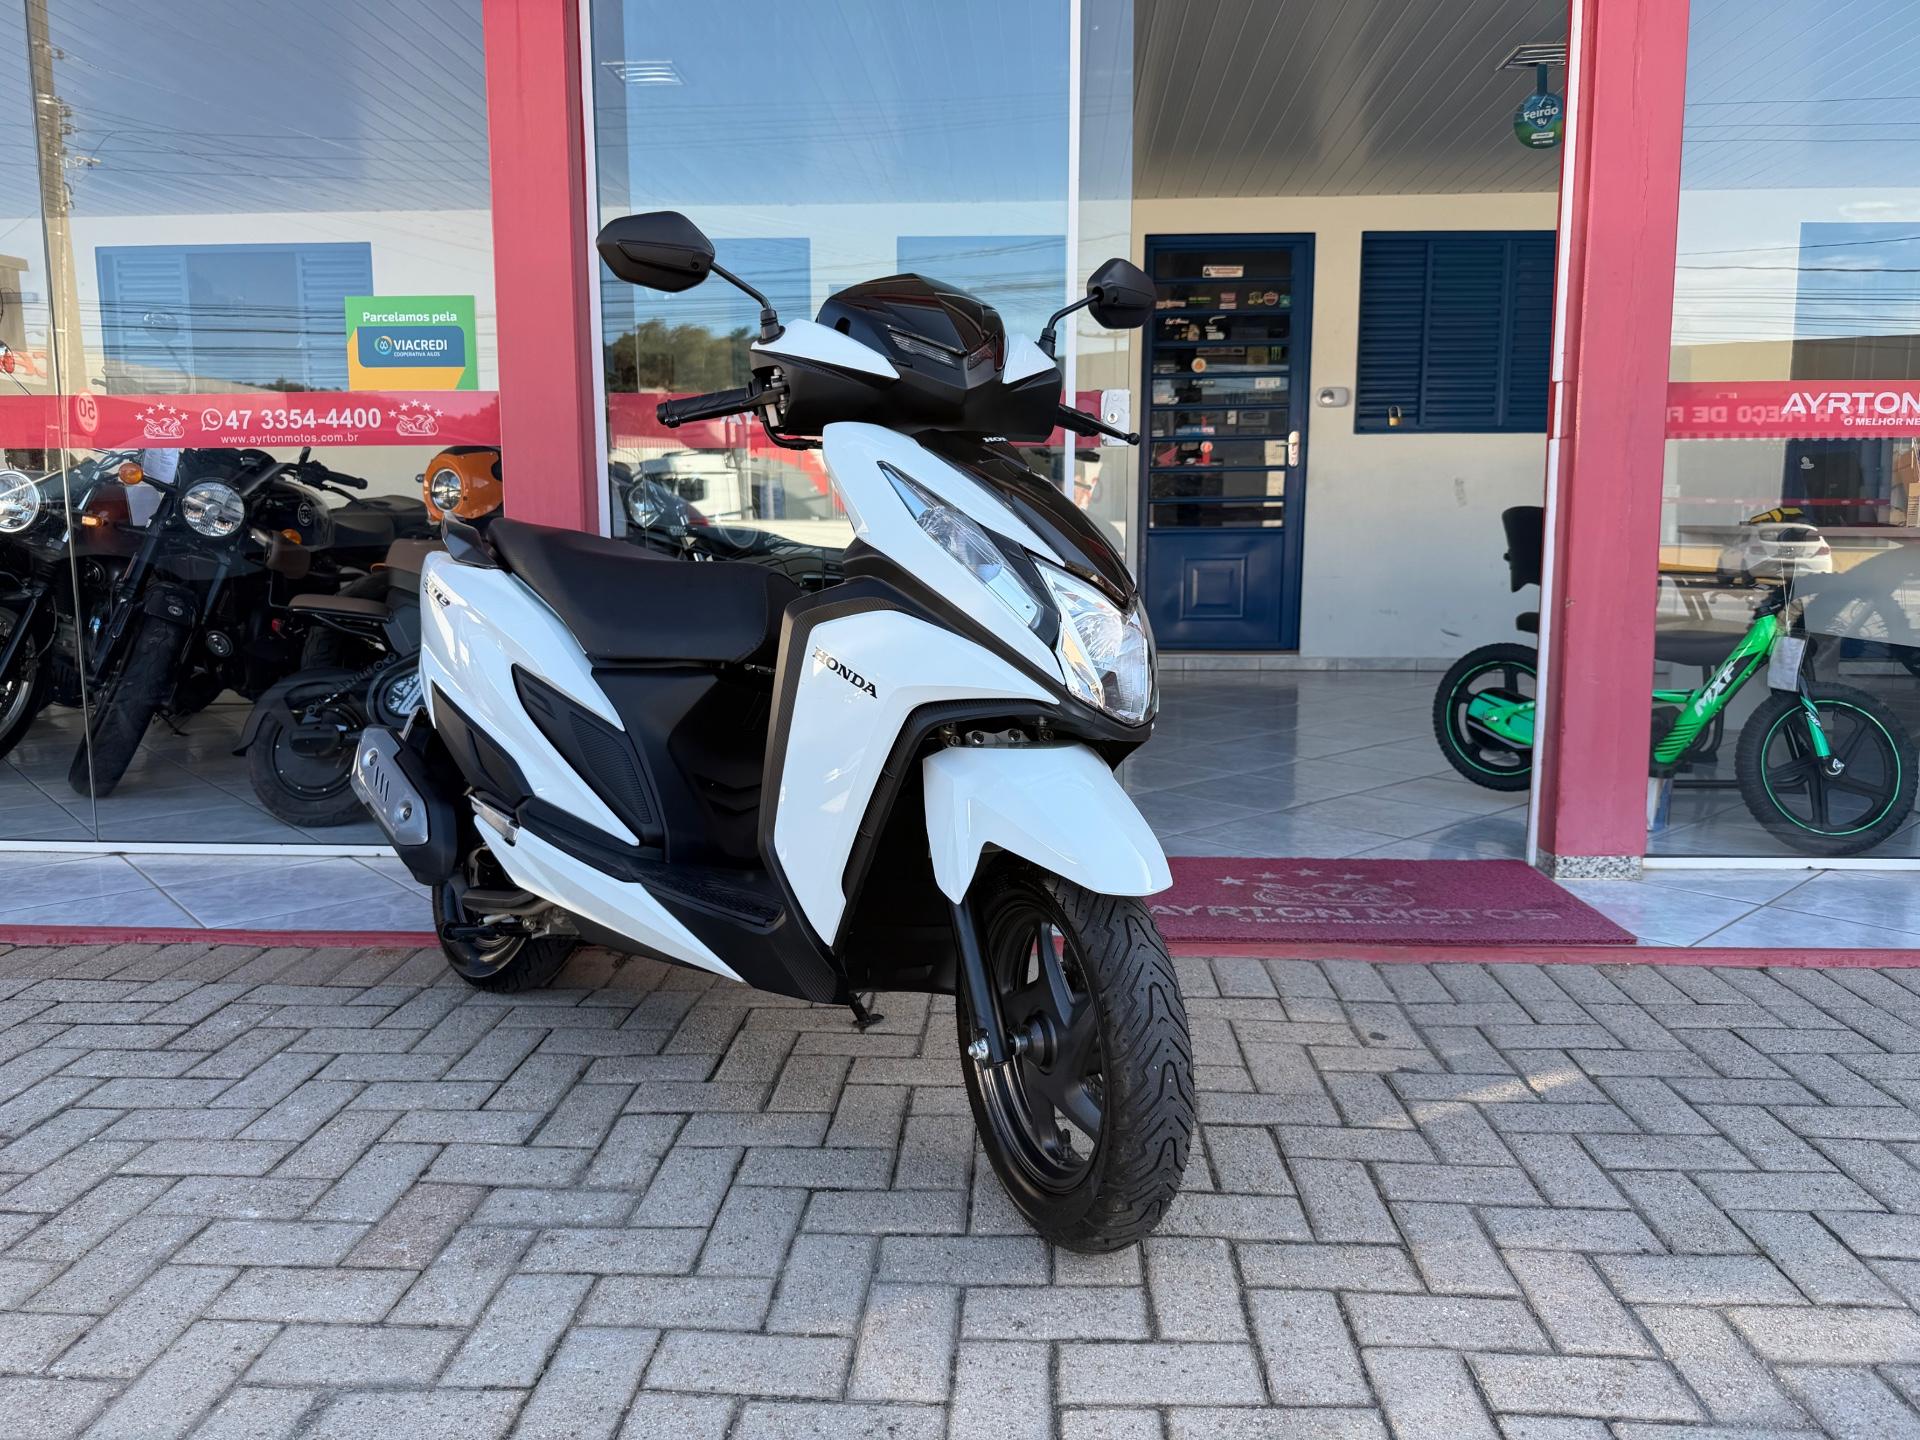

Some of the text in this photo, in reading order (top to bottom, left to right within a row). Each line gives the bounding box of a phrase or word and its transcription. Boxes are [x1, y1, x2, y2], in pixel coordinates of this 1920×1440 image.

[1523, 105, 1559, 122] Feirão
[362, 311, 458, 325] Parcelamos pela
[393, 339, 448, 351] VIACREDI
[1780, 391, 1920, 415] AYRTON
[225, 407, 382, 430] 47 3354-4400
[1843, 417, 1853, 426] O
[1855, 416, 1903, 426] MELHOR
[220, 433, 359, 446] www.ayrtonmotos.com.br
[812, 646, 878, 699] HONDA
[1150, 904, 1563, 921] AYRTON MOTOS
